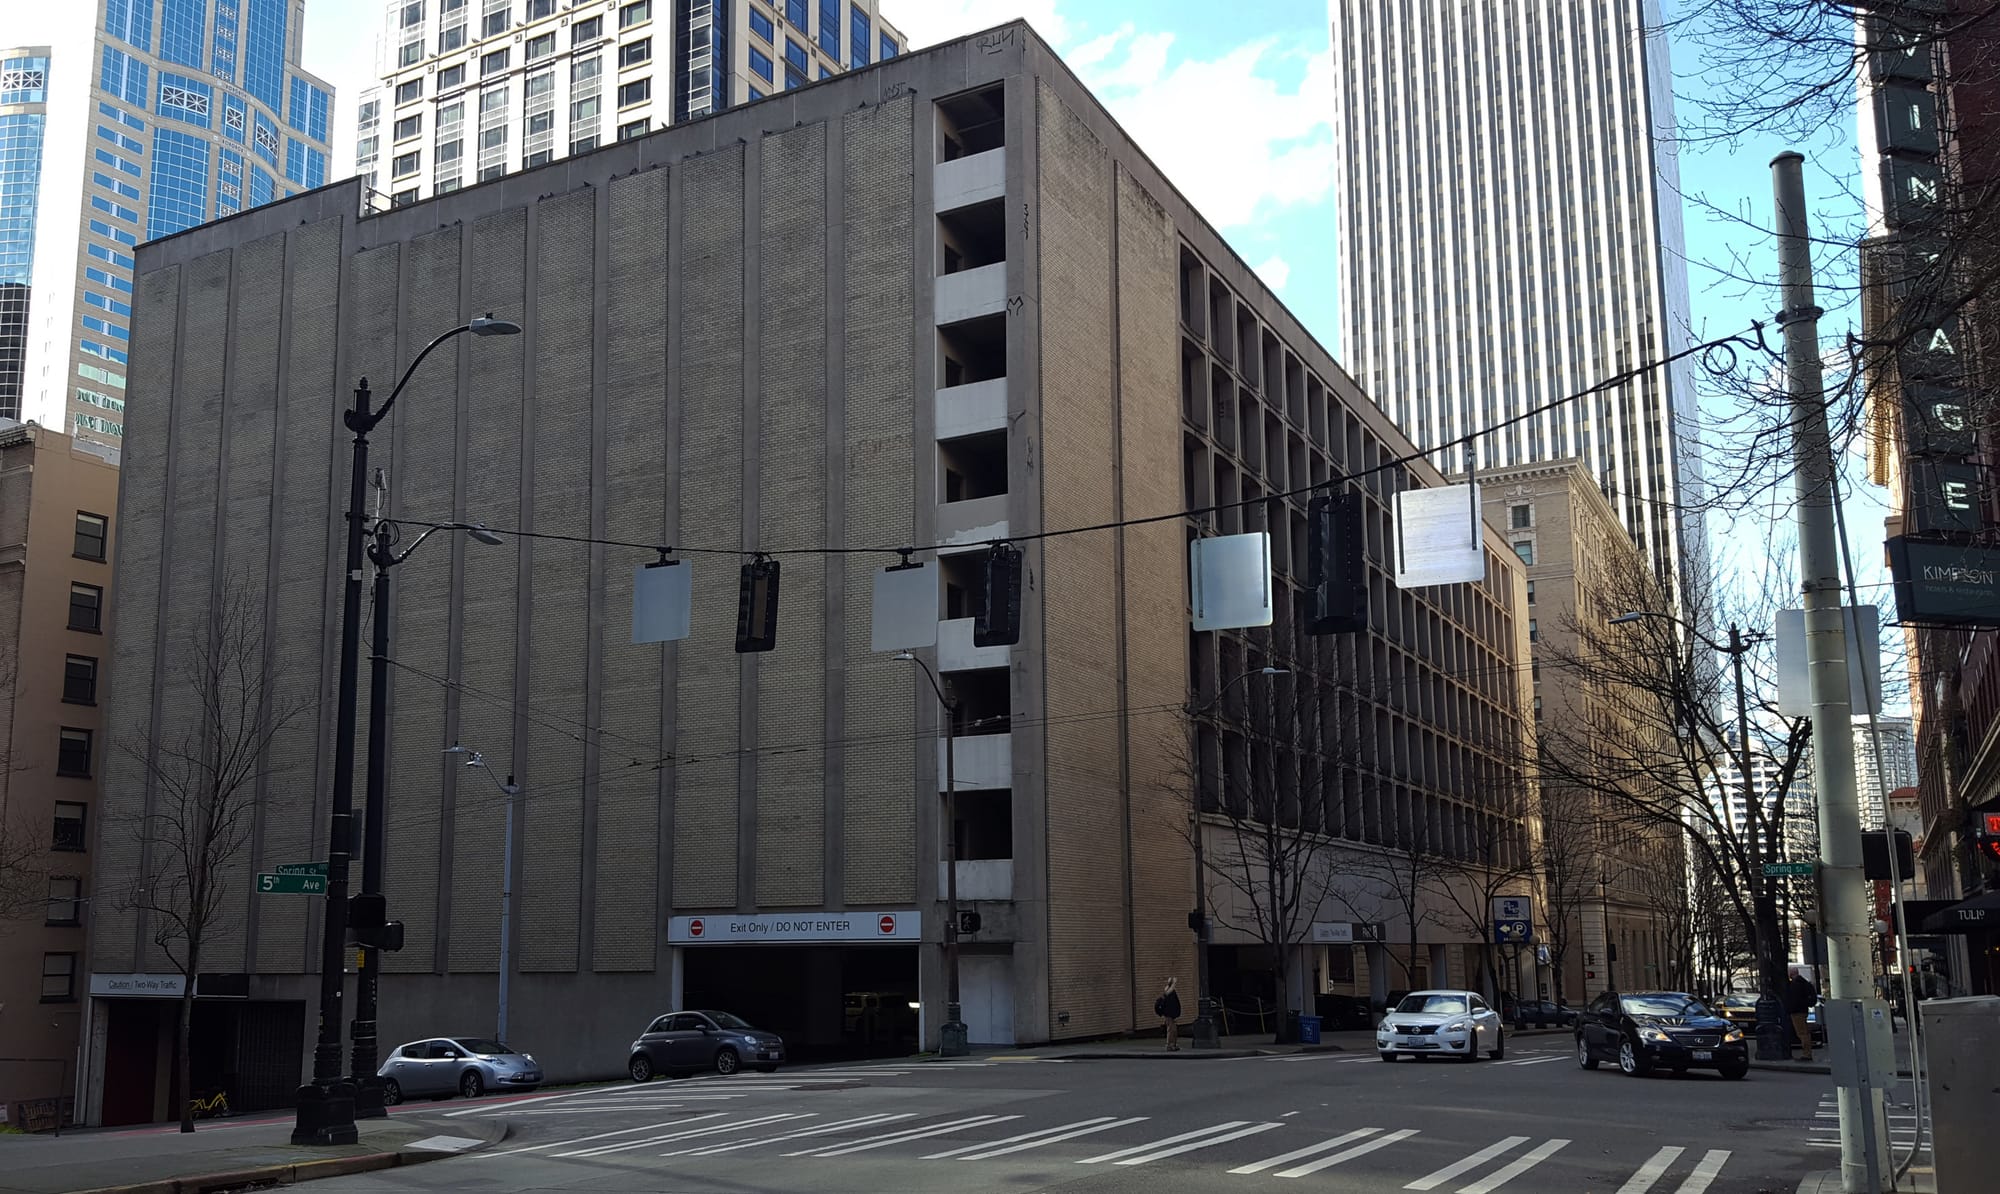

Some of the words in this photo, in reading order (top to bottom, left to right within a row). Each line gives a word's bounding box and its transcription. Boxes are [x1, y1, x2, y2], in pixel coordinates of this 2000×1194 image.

[1891, 32, 1970, 510] VINAGE
[1765, 864, 1792, 874] Spring
[262, 876, 280, 891] 5th
[302, 880, 320, 890] Ave
[730, 922, 747, 933] Exit
[748, 922, 769, 934] Only
[776, 921, 791, 932] DO
[793, 921, 813, 932] NOT
[816, 920, 850, 931] ENTER
[108, 979, 130, 989] Caution
[160, 980, 177, 989] Traffic
